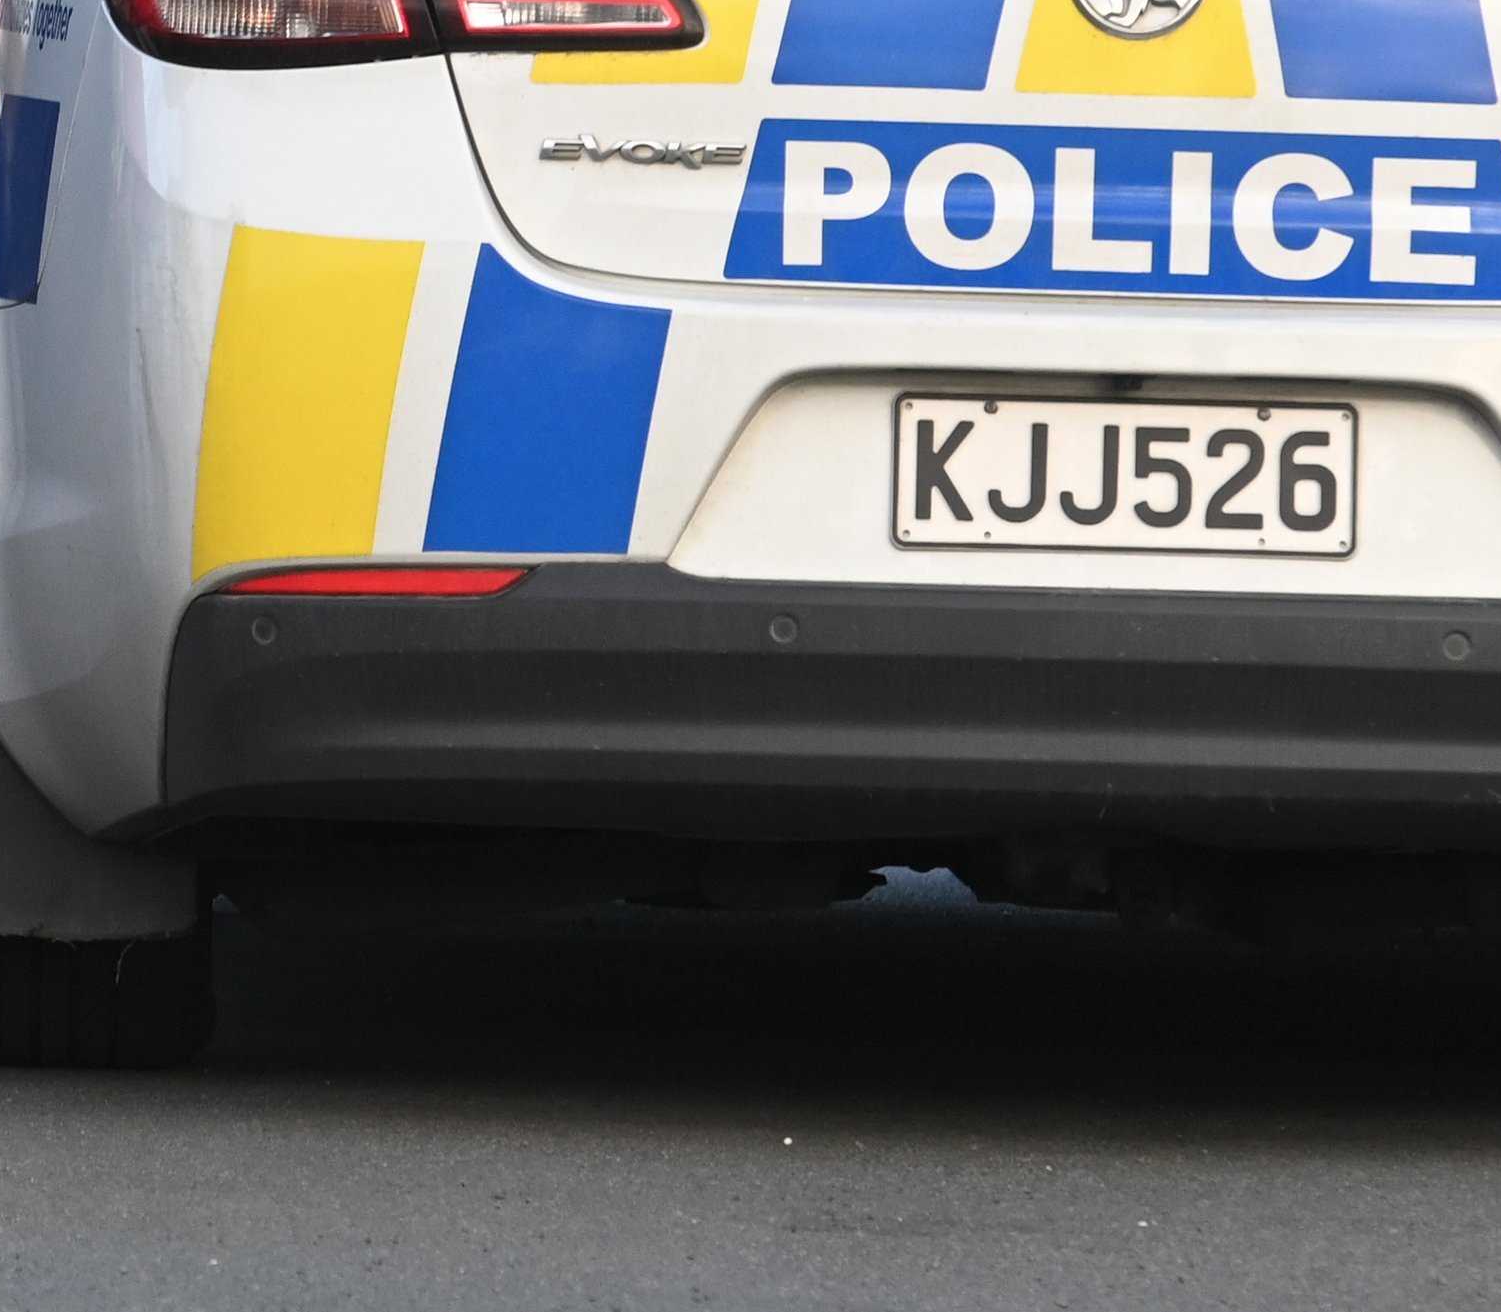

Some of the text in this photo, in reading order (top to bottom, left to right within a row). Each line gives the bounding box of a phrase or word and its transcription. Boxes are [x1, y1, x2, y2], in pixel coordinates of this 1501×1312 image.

[539, 133, 747, 170] EVOKE
[784, 141, 1477, 286] POLICE
[915, 419, 1337, 531] KJJ526
